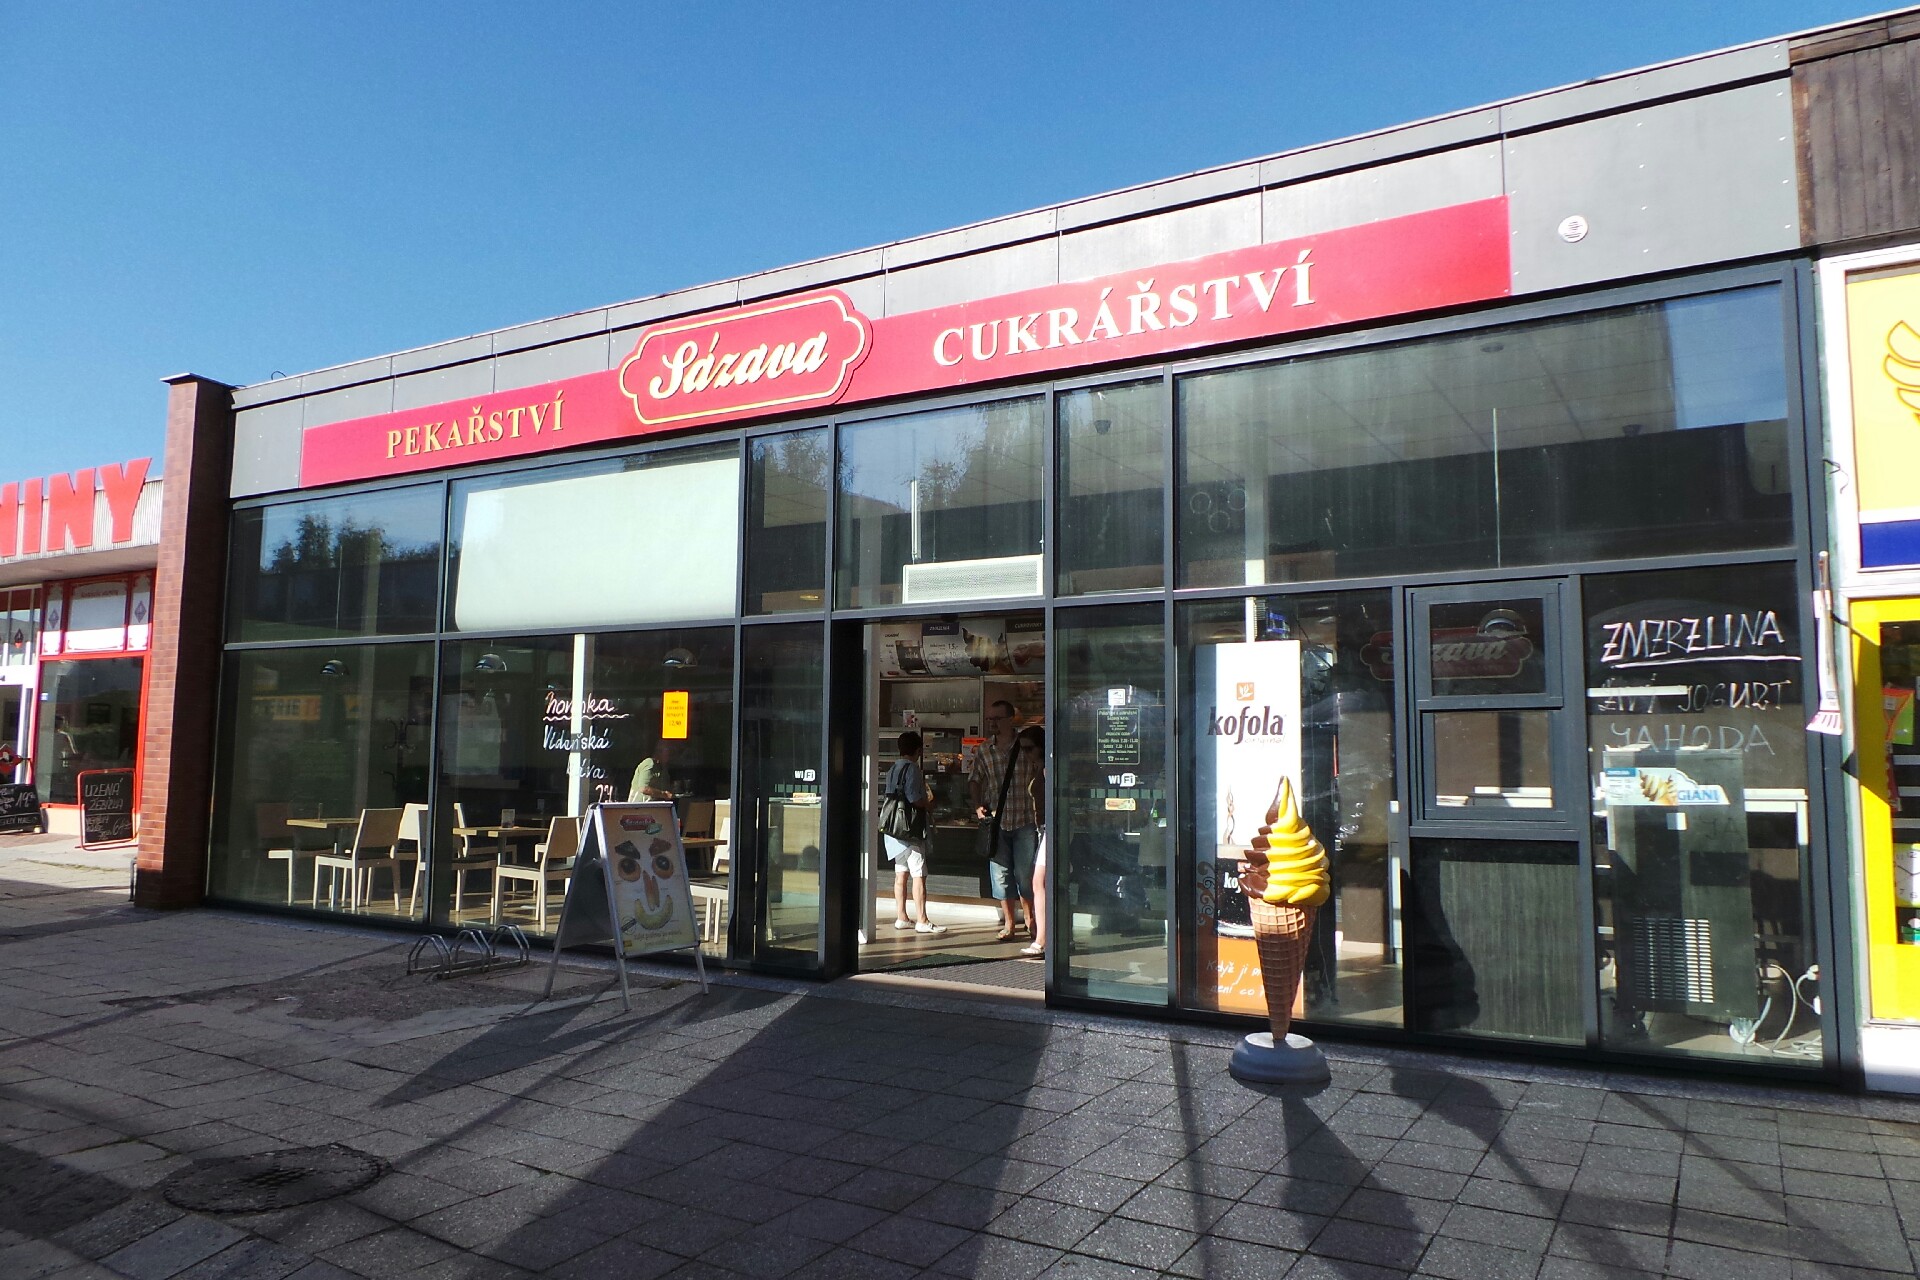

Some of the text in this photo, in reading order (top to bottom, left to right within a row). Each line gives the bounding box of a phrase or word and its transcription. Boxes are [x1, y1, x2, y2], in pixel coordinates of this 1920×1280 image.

[933, 249, 1316, 366] CUKRÁŘSTVÍ
[649, 331, 829, 400] Sázava
[386, 390, 564, 459] PEKAŘSTVÍ
[1207, 705, 1284, 745] kofola
[1677, 679, 1792, 711] JOGURT
